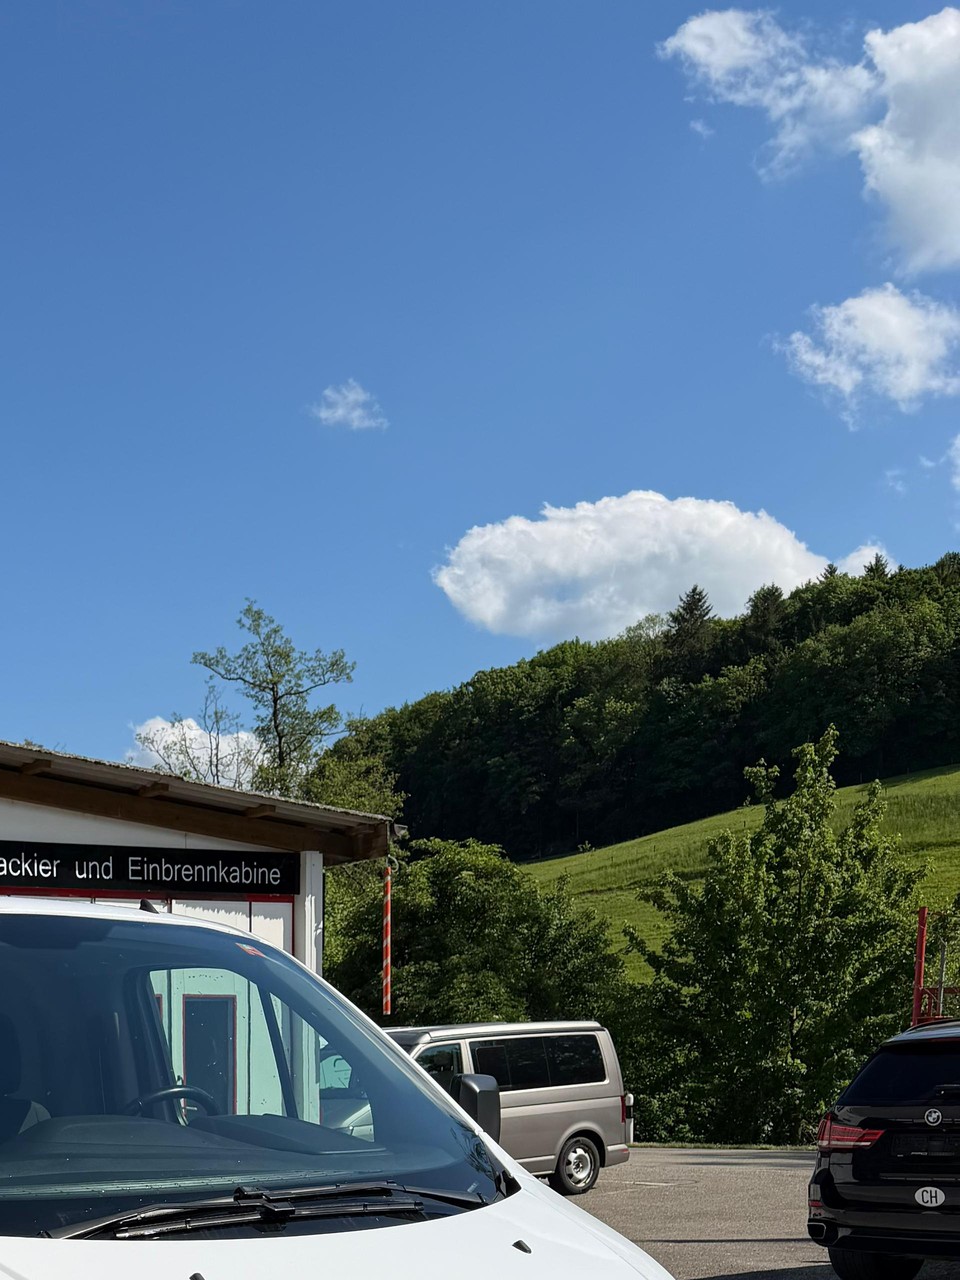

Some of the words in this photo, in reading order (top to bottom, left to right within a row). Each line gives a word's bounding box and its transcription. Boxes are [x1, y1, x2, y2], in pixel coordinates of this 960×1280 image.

[75, 856, 113, 880] und
[128, 856, 281, 885] Einbrennkabine
[921, 1190, 938, 1204] CH
